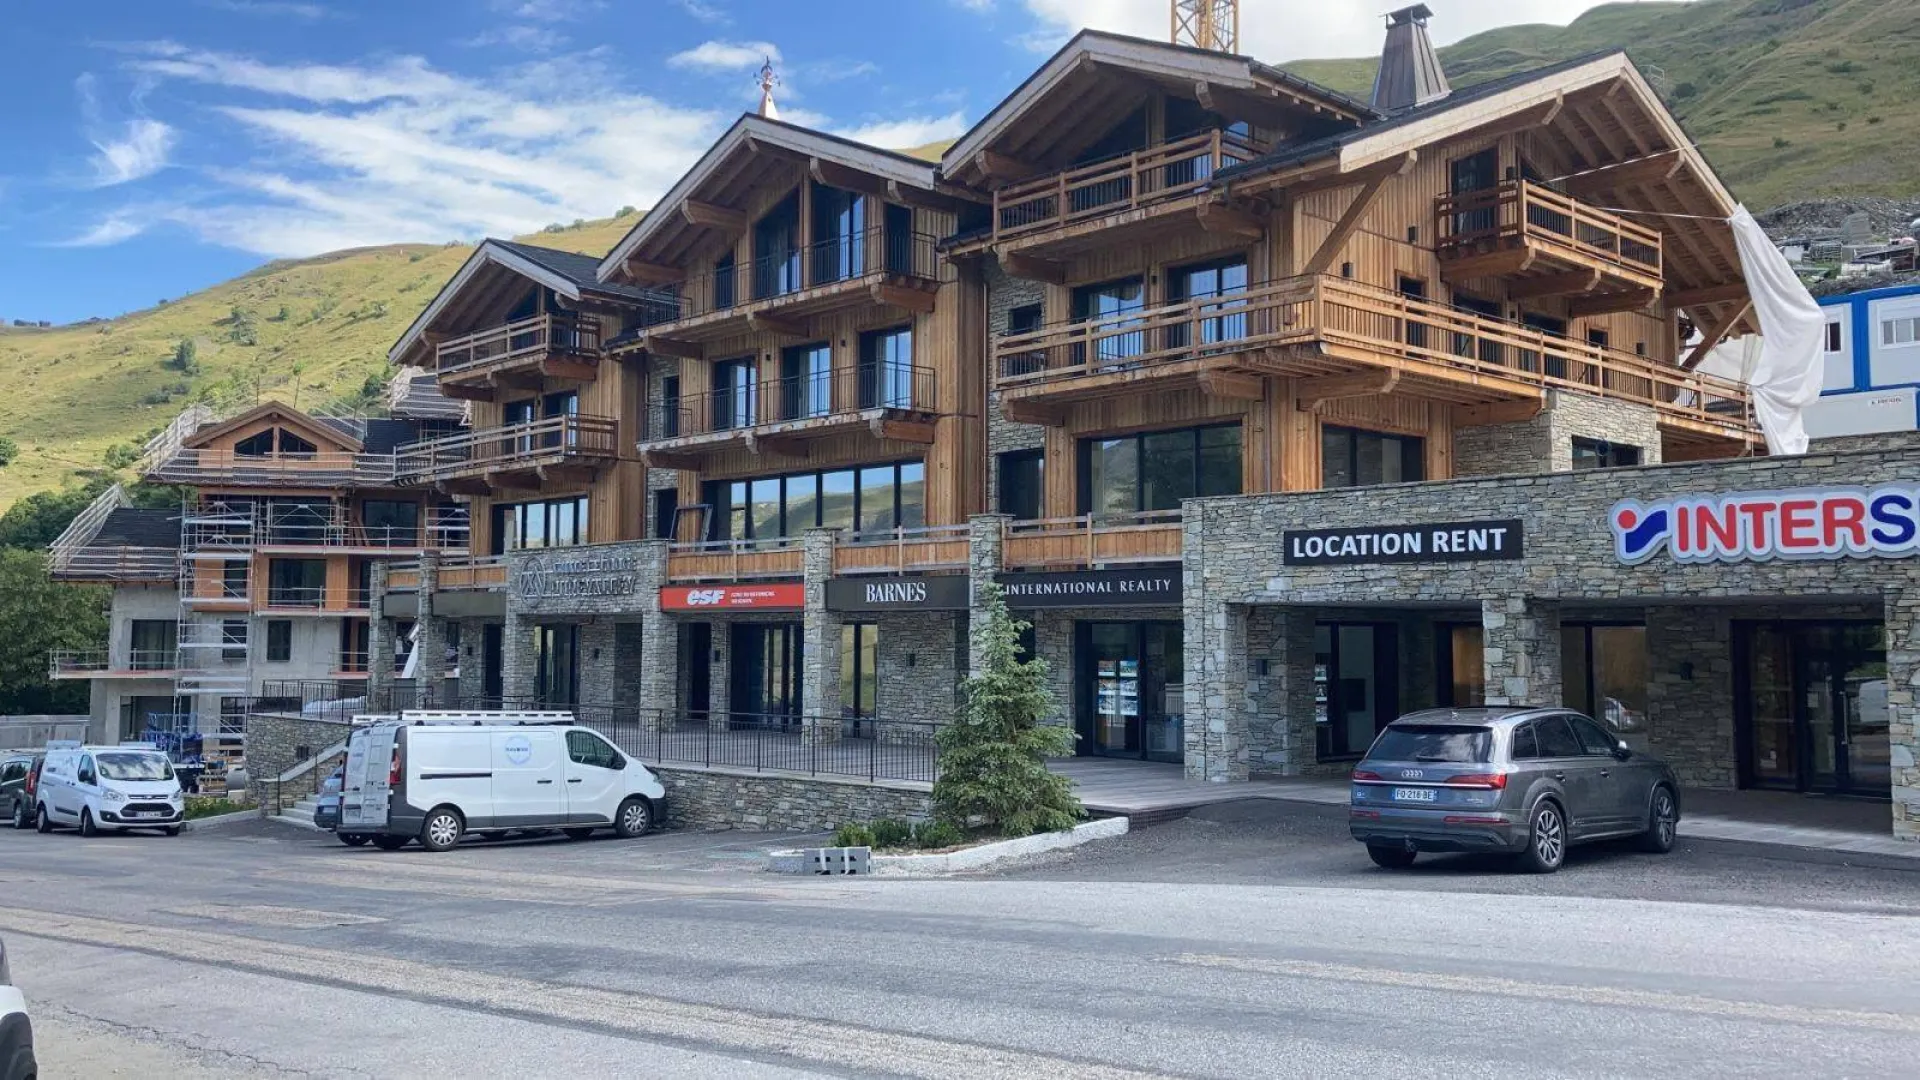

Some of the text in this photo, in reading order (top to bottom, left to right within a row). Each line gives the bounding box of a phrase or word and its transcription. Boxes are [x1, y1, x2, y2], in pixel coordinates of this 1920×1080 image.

[1293, 527, 1507, 558] LOCATION RENT
[866, 581, 927, 603] BARNES
[1006, 578, 1172, 596] INTERNATIONAL REALTY
